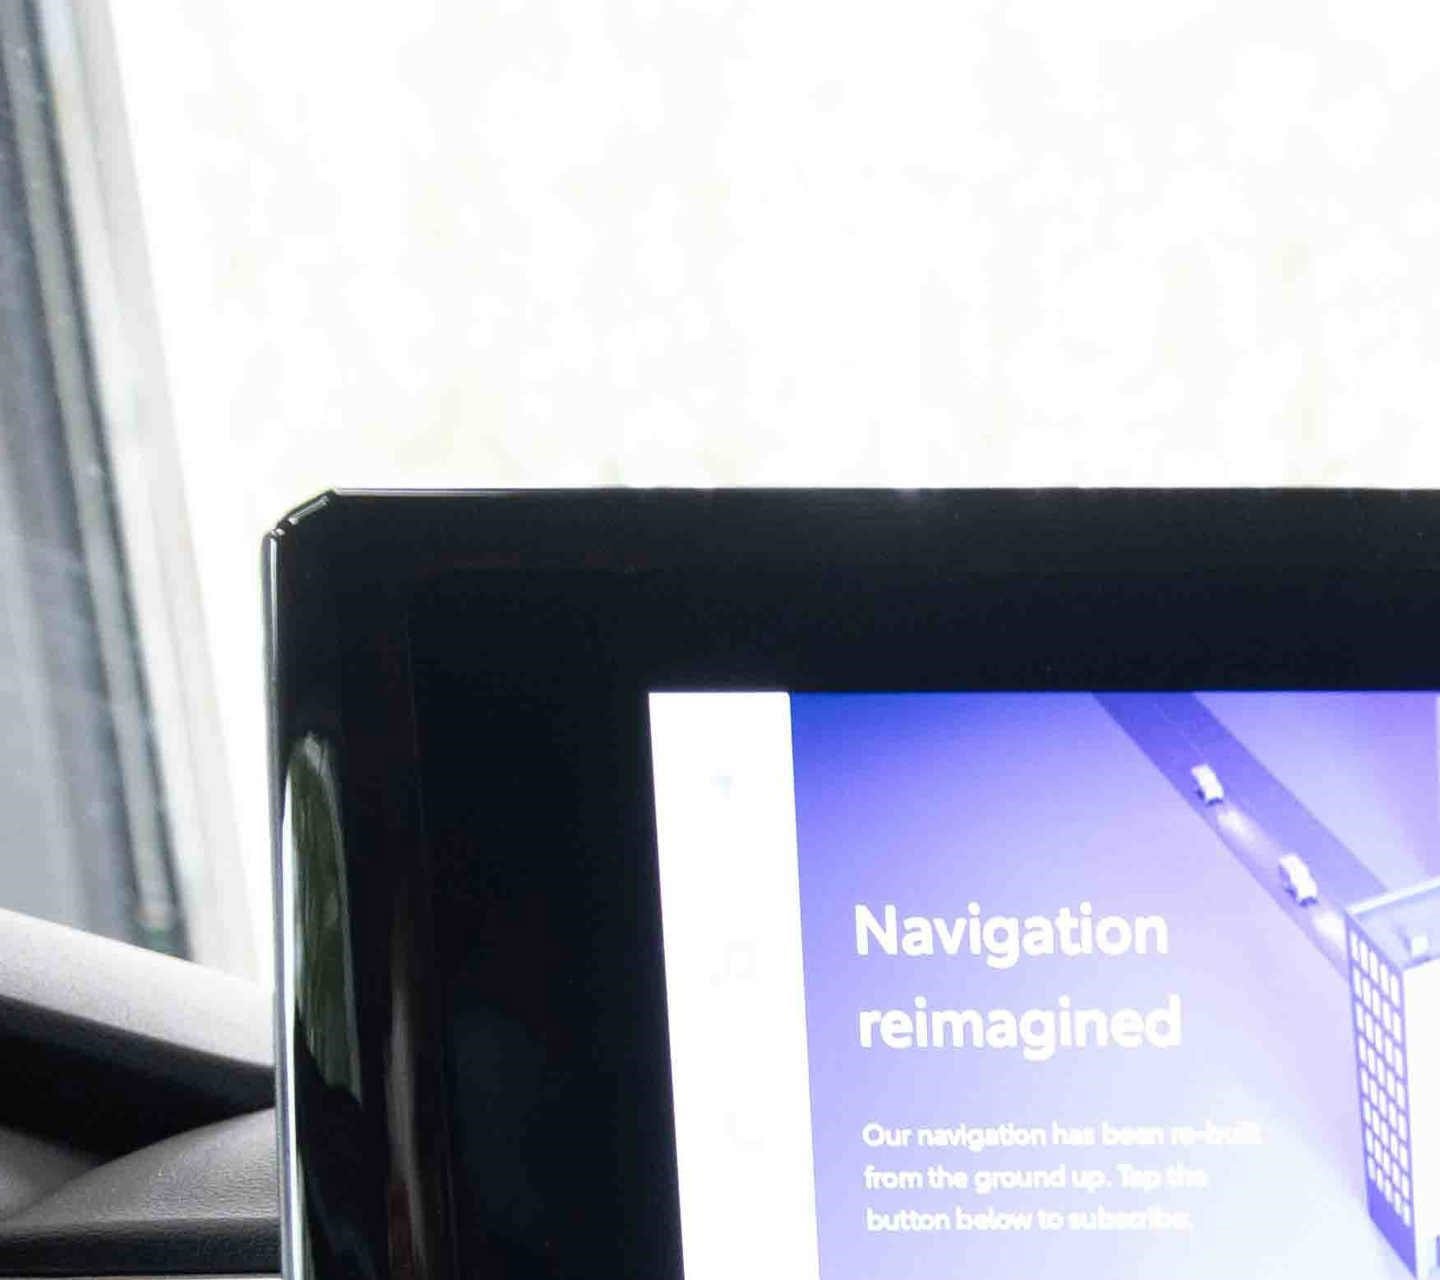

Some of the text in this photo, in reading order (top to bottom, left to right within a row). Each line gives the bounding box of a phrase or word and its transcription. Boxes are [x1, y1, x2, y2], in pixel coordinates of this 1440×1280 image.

[854, 900, 1170, 970] Navigation
[858, 993, 1183, 1062] reimagined
[861, 1122, 911, 1148] Our
[917, 1122, 1048, 1152] navigation
[1052, 1120, 1097, 1146] has
[1101, 1121, 1163, 1146] been
[863, 1161, 1209, 1194] from the ground up. Tap the
[865, 1207, 950, 1231] button
[955, 1206, 1032, 1231] below
[1037, 1208, 1063, 1231] to
